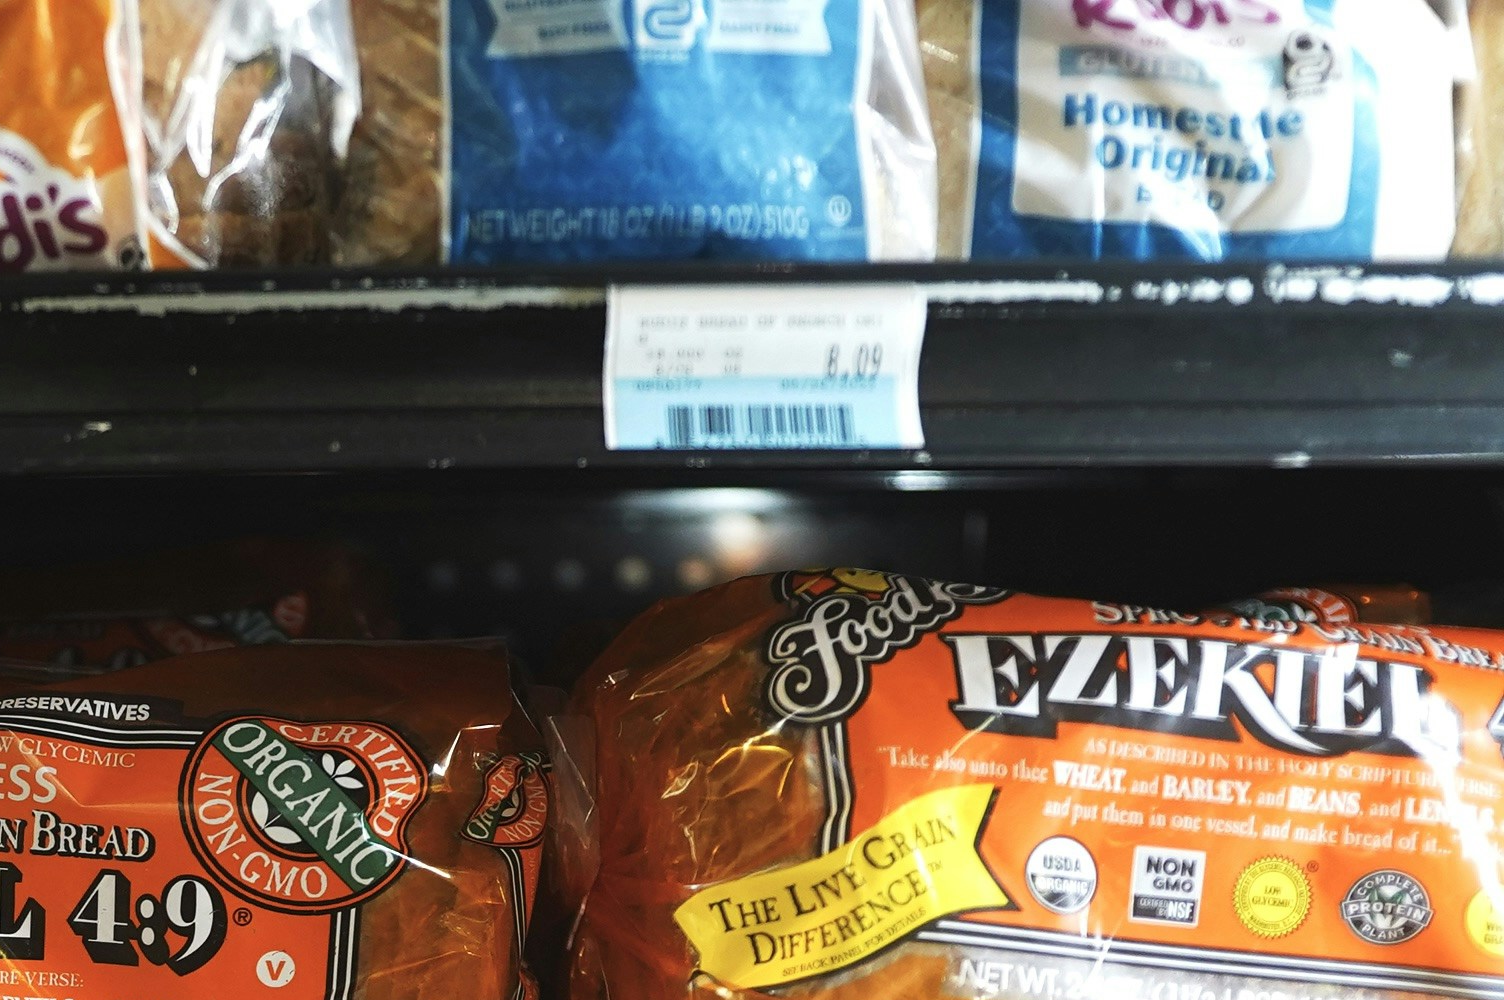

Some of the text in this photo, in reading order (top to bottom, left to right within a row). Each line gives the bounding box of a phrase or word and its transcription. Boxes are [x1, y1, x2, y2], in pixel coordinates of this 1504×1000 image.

[1097, 135, 1277, 184] Original
[825, 343, 884, 381] 8.09
[946, 633, 1462, 756] EZEKIEL
[18, 737, 137, 769] GLYCEMIC
[277, 723, 413, 838] CERTIFIED
[1051, 761, 1126, 793] WHEAT,
[222, 722, 396, 886] ORGANIC
[32, 809, 152, 859] BREAD
[197, 771, 328, 899] NON-GMO
[709, 816, 958, 934] THE LIVE GRAIN
[1145, 854, 1198, 877] NON
[1152, 875, 1195, 894] GMO
[73, 872, 216, 963] 4:9
[1346, 902, 1429, 923] PROTEIN
[24, 971, 85, 988] VERSE:
[265, 959, 286, 981] V
